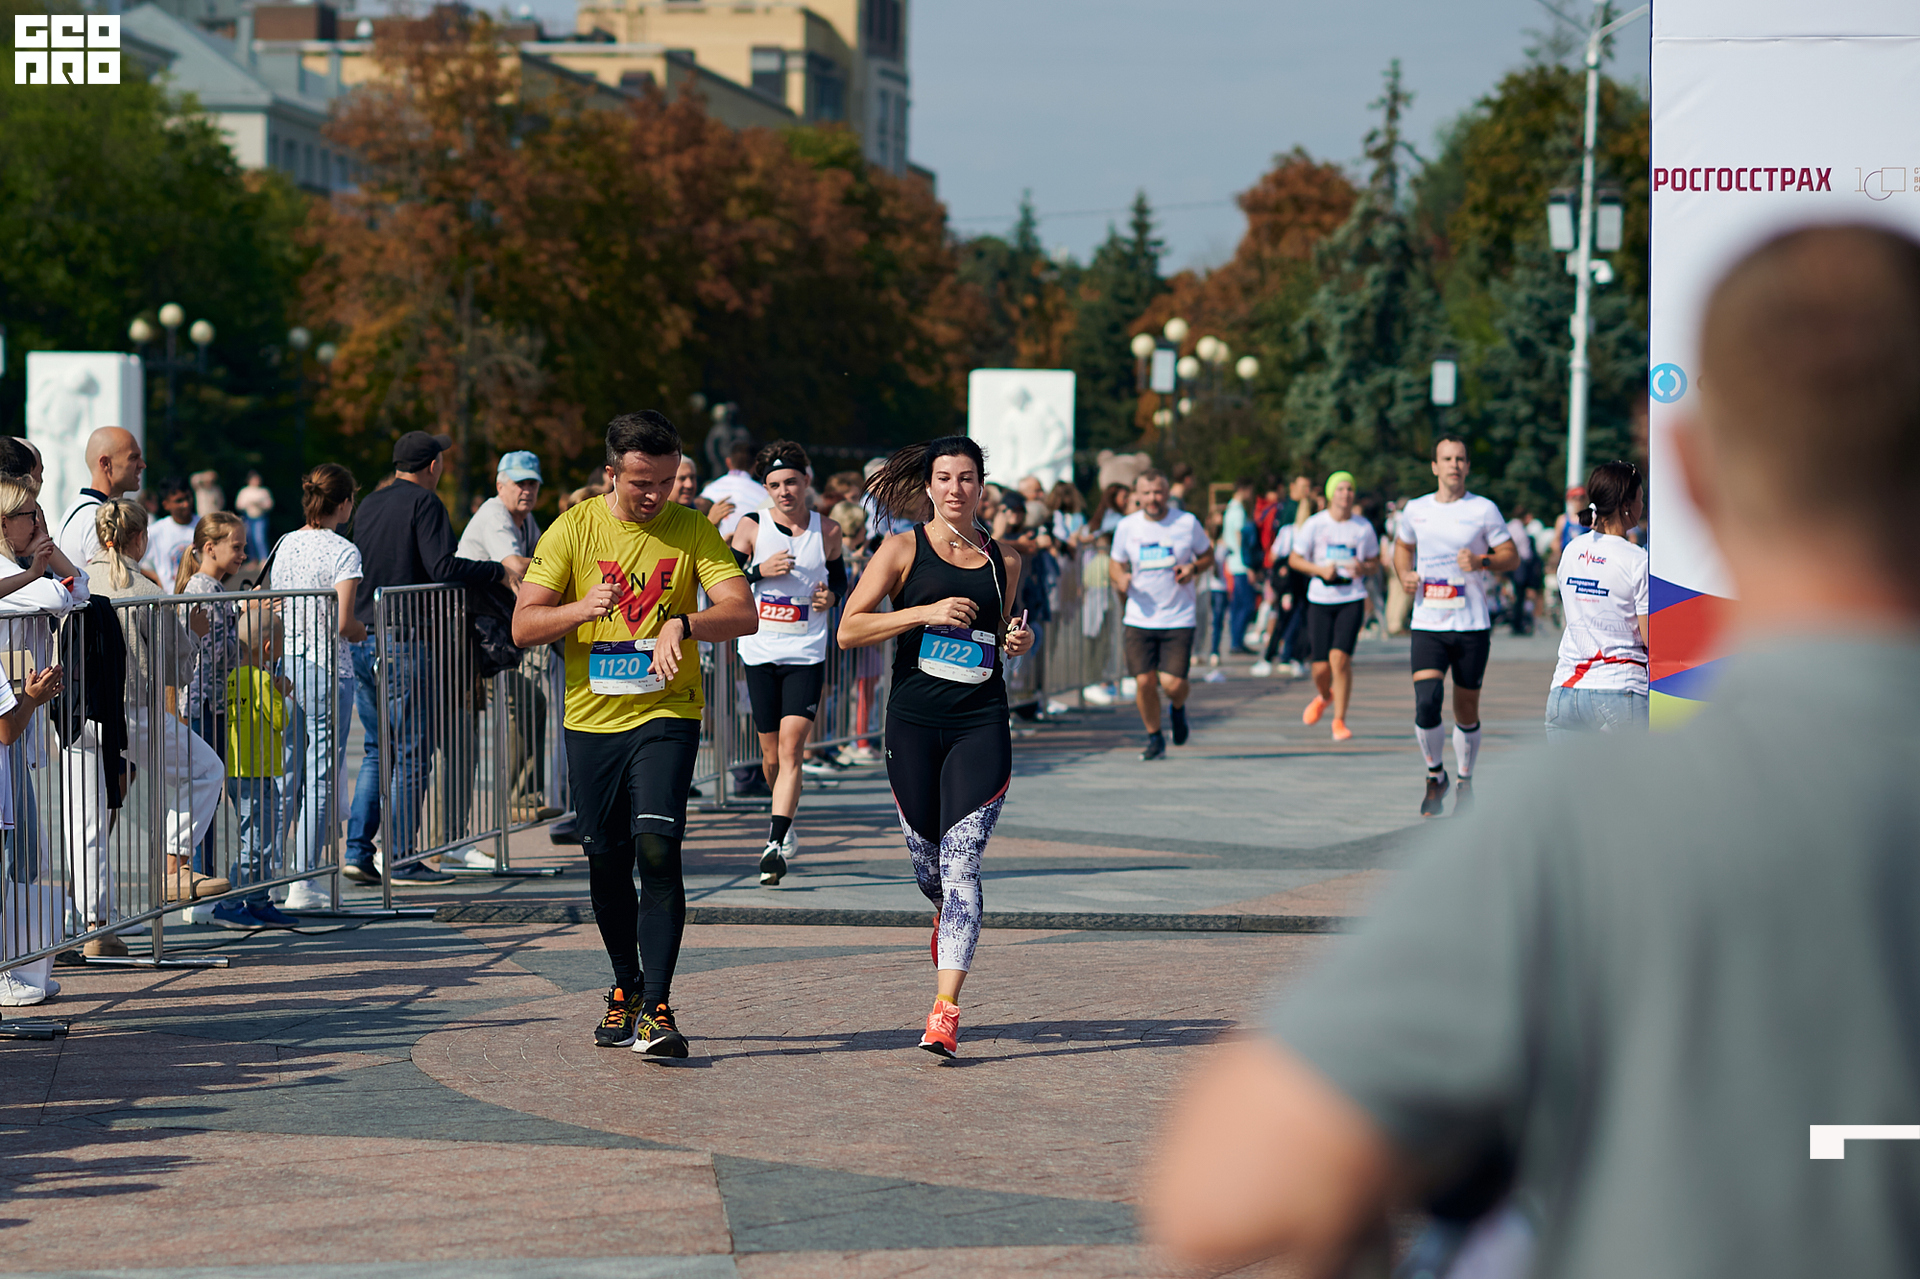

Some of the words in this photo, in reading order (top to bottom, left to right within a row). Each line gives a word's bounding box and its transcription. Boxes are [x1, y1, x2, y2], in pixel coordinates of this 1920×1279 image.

[1653, 167, 1832, 192] РОСГОССТРАХ
[760, 604, 795, 621] 2122
[930, 640, 973, 664] 1122
[599, 657, 641, 677] 1120
